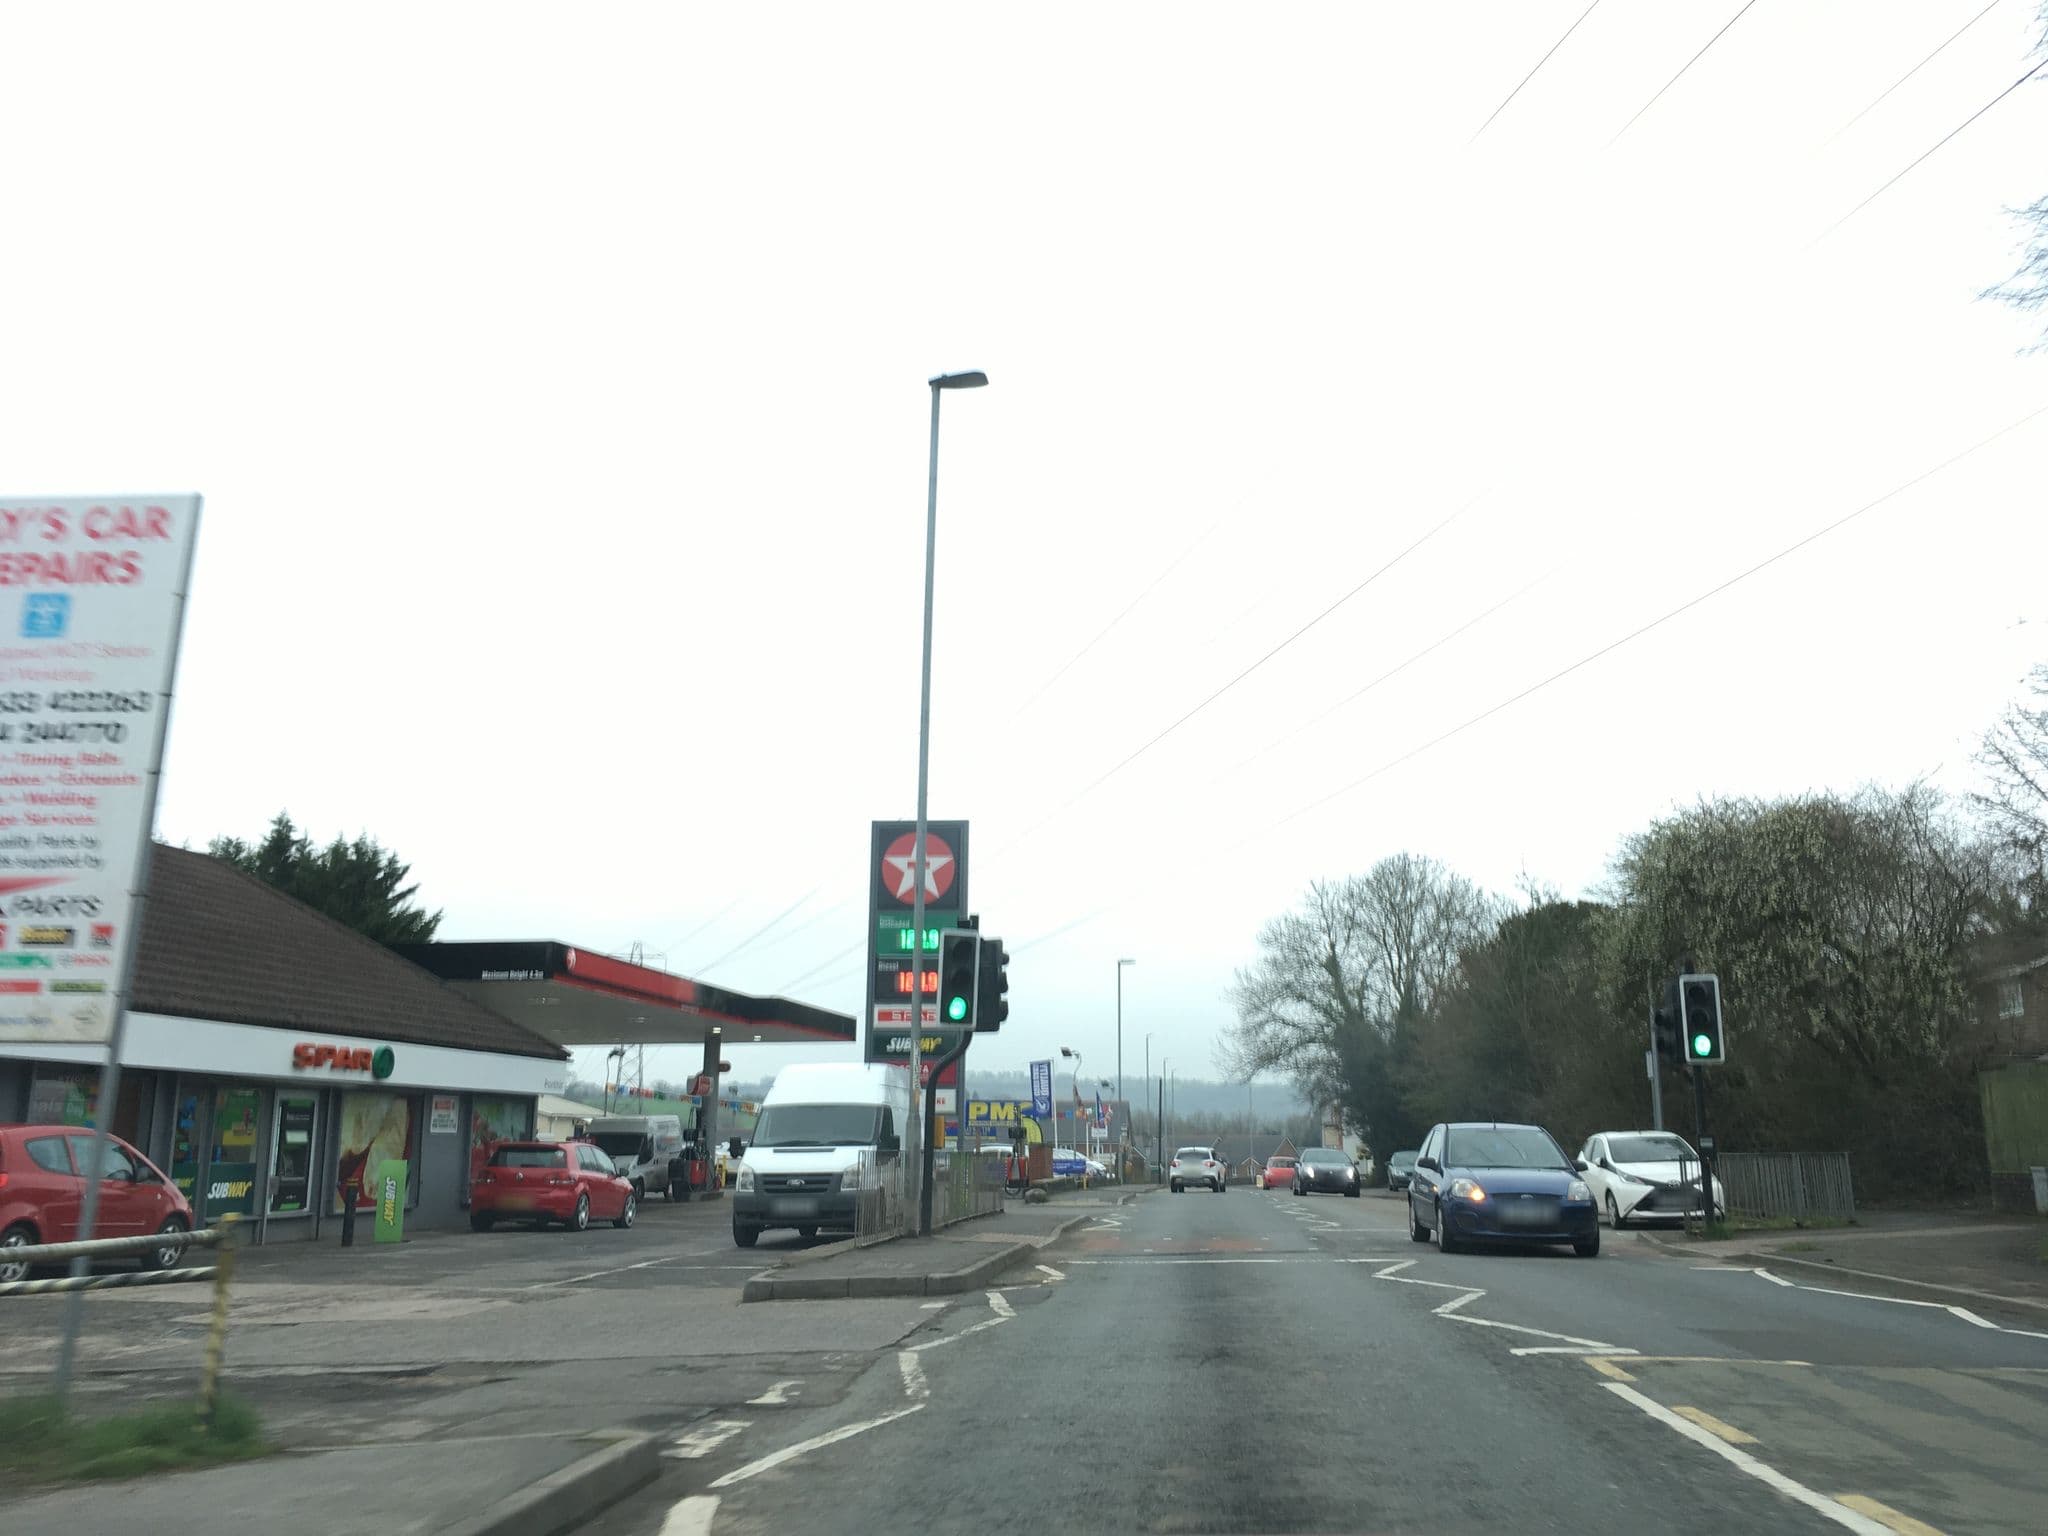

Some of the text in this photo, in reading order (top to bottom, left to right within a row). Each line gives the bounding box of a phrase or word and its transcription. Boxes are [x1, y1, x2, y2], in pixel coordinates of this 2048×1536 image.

[82, 506, 171, 540] CAR
[292, 1042, 373, 1072] SPAR
[886, 1037, 942, 1053] SUBAY
[207, 1180, 253, 1199] SUBWAY
[383, 1176, 396, 1226] SUBWAY
